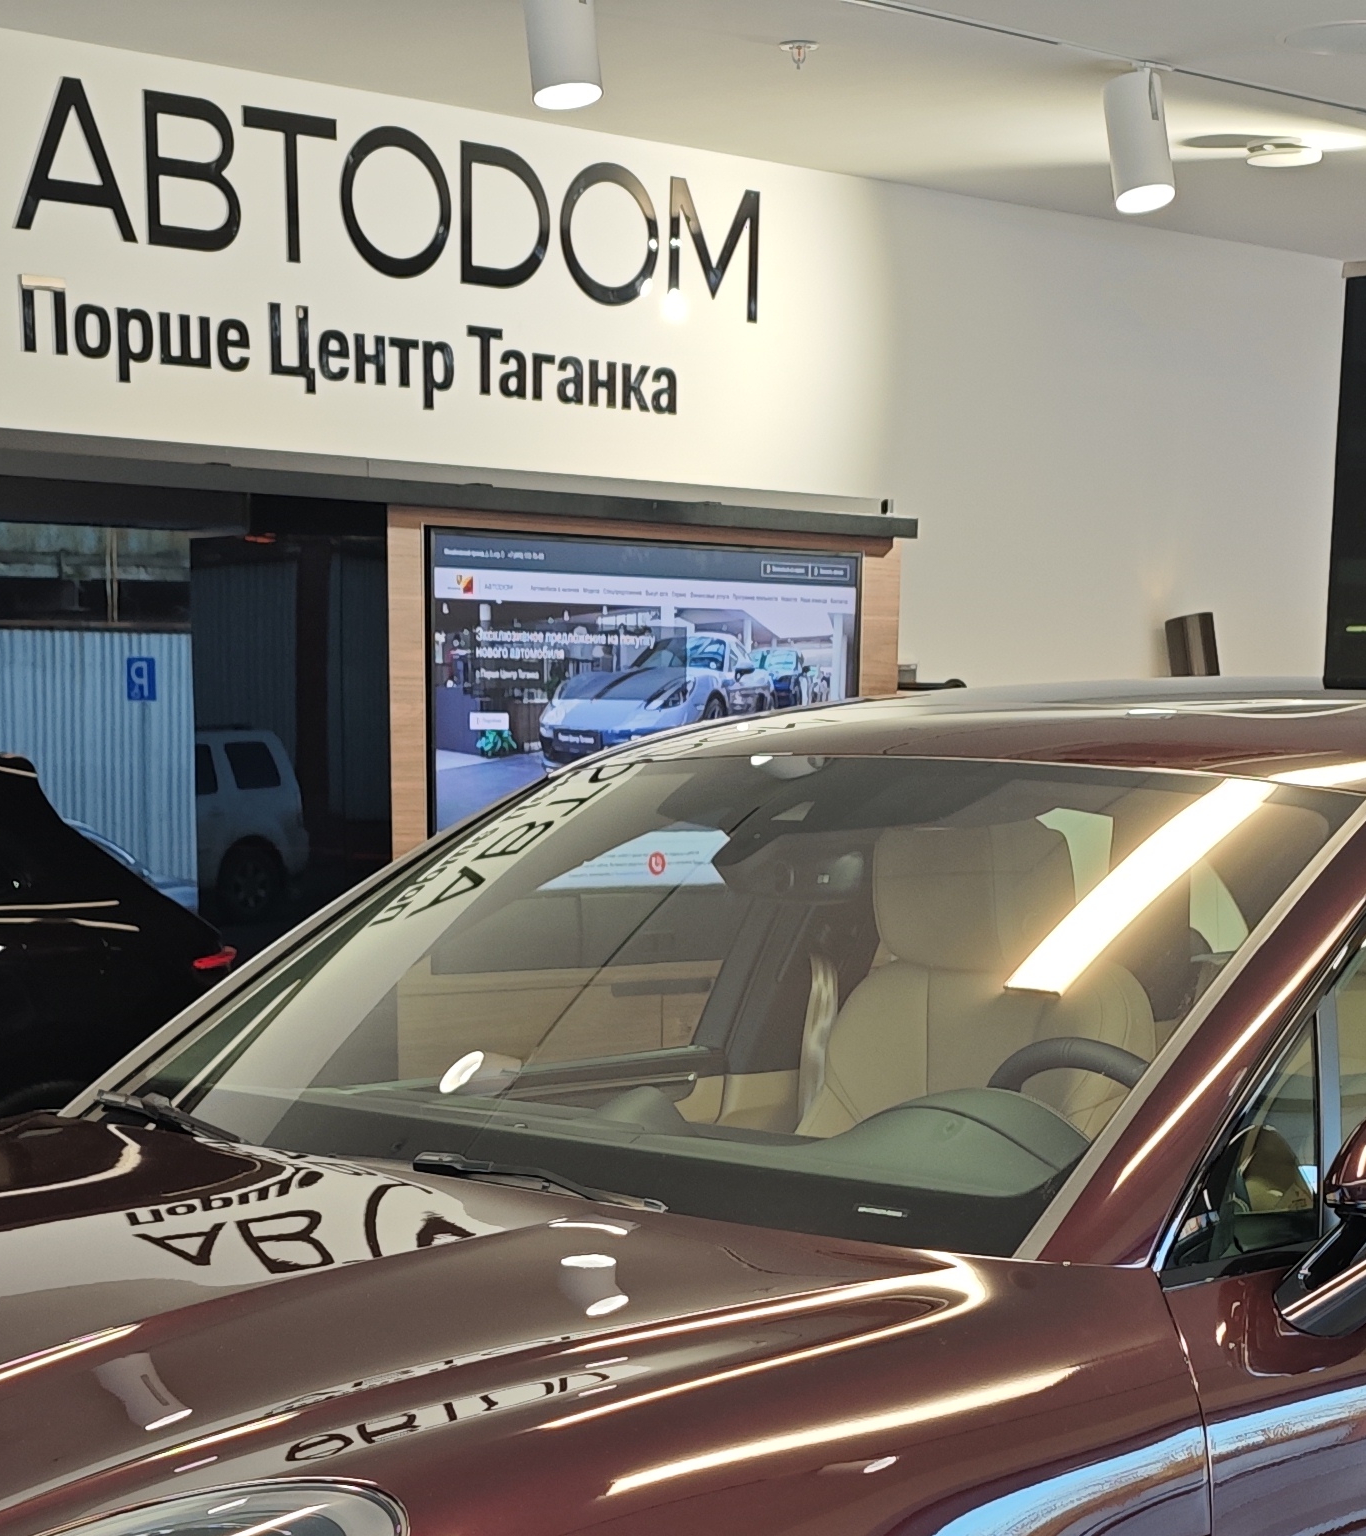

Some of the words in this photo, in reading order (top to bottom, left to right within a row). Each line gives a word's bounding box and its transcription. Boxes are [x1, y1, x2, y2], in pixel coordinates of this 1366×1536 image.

[19, 274, 250, 383] Порше
[268, 302, 455, 409] Центр
[467, 325, 678, 415] Таганка
